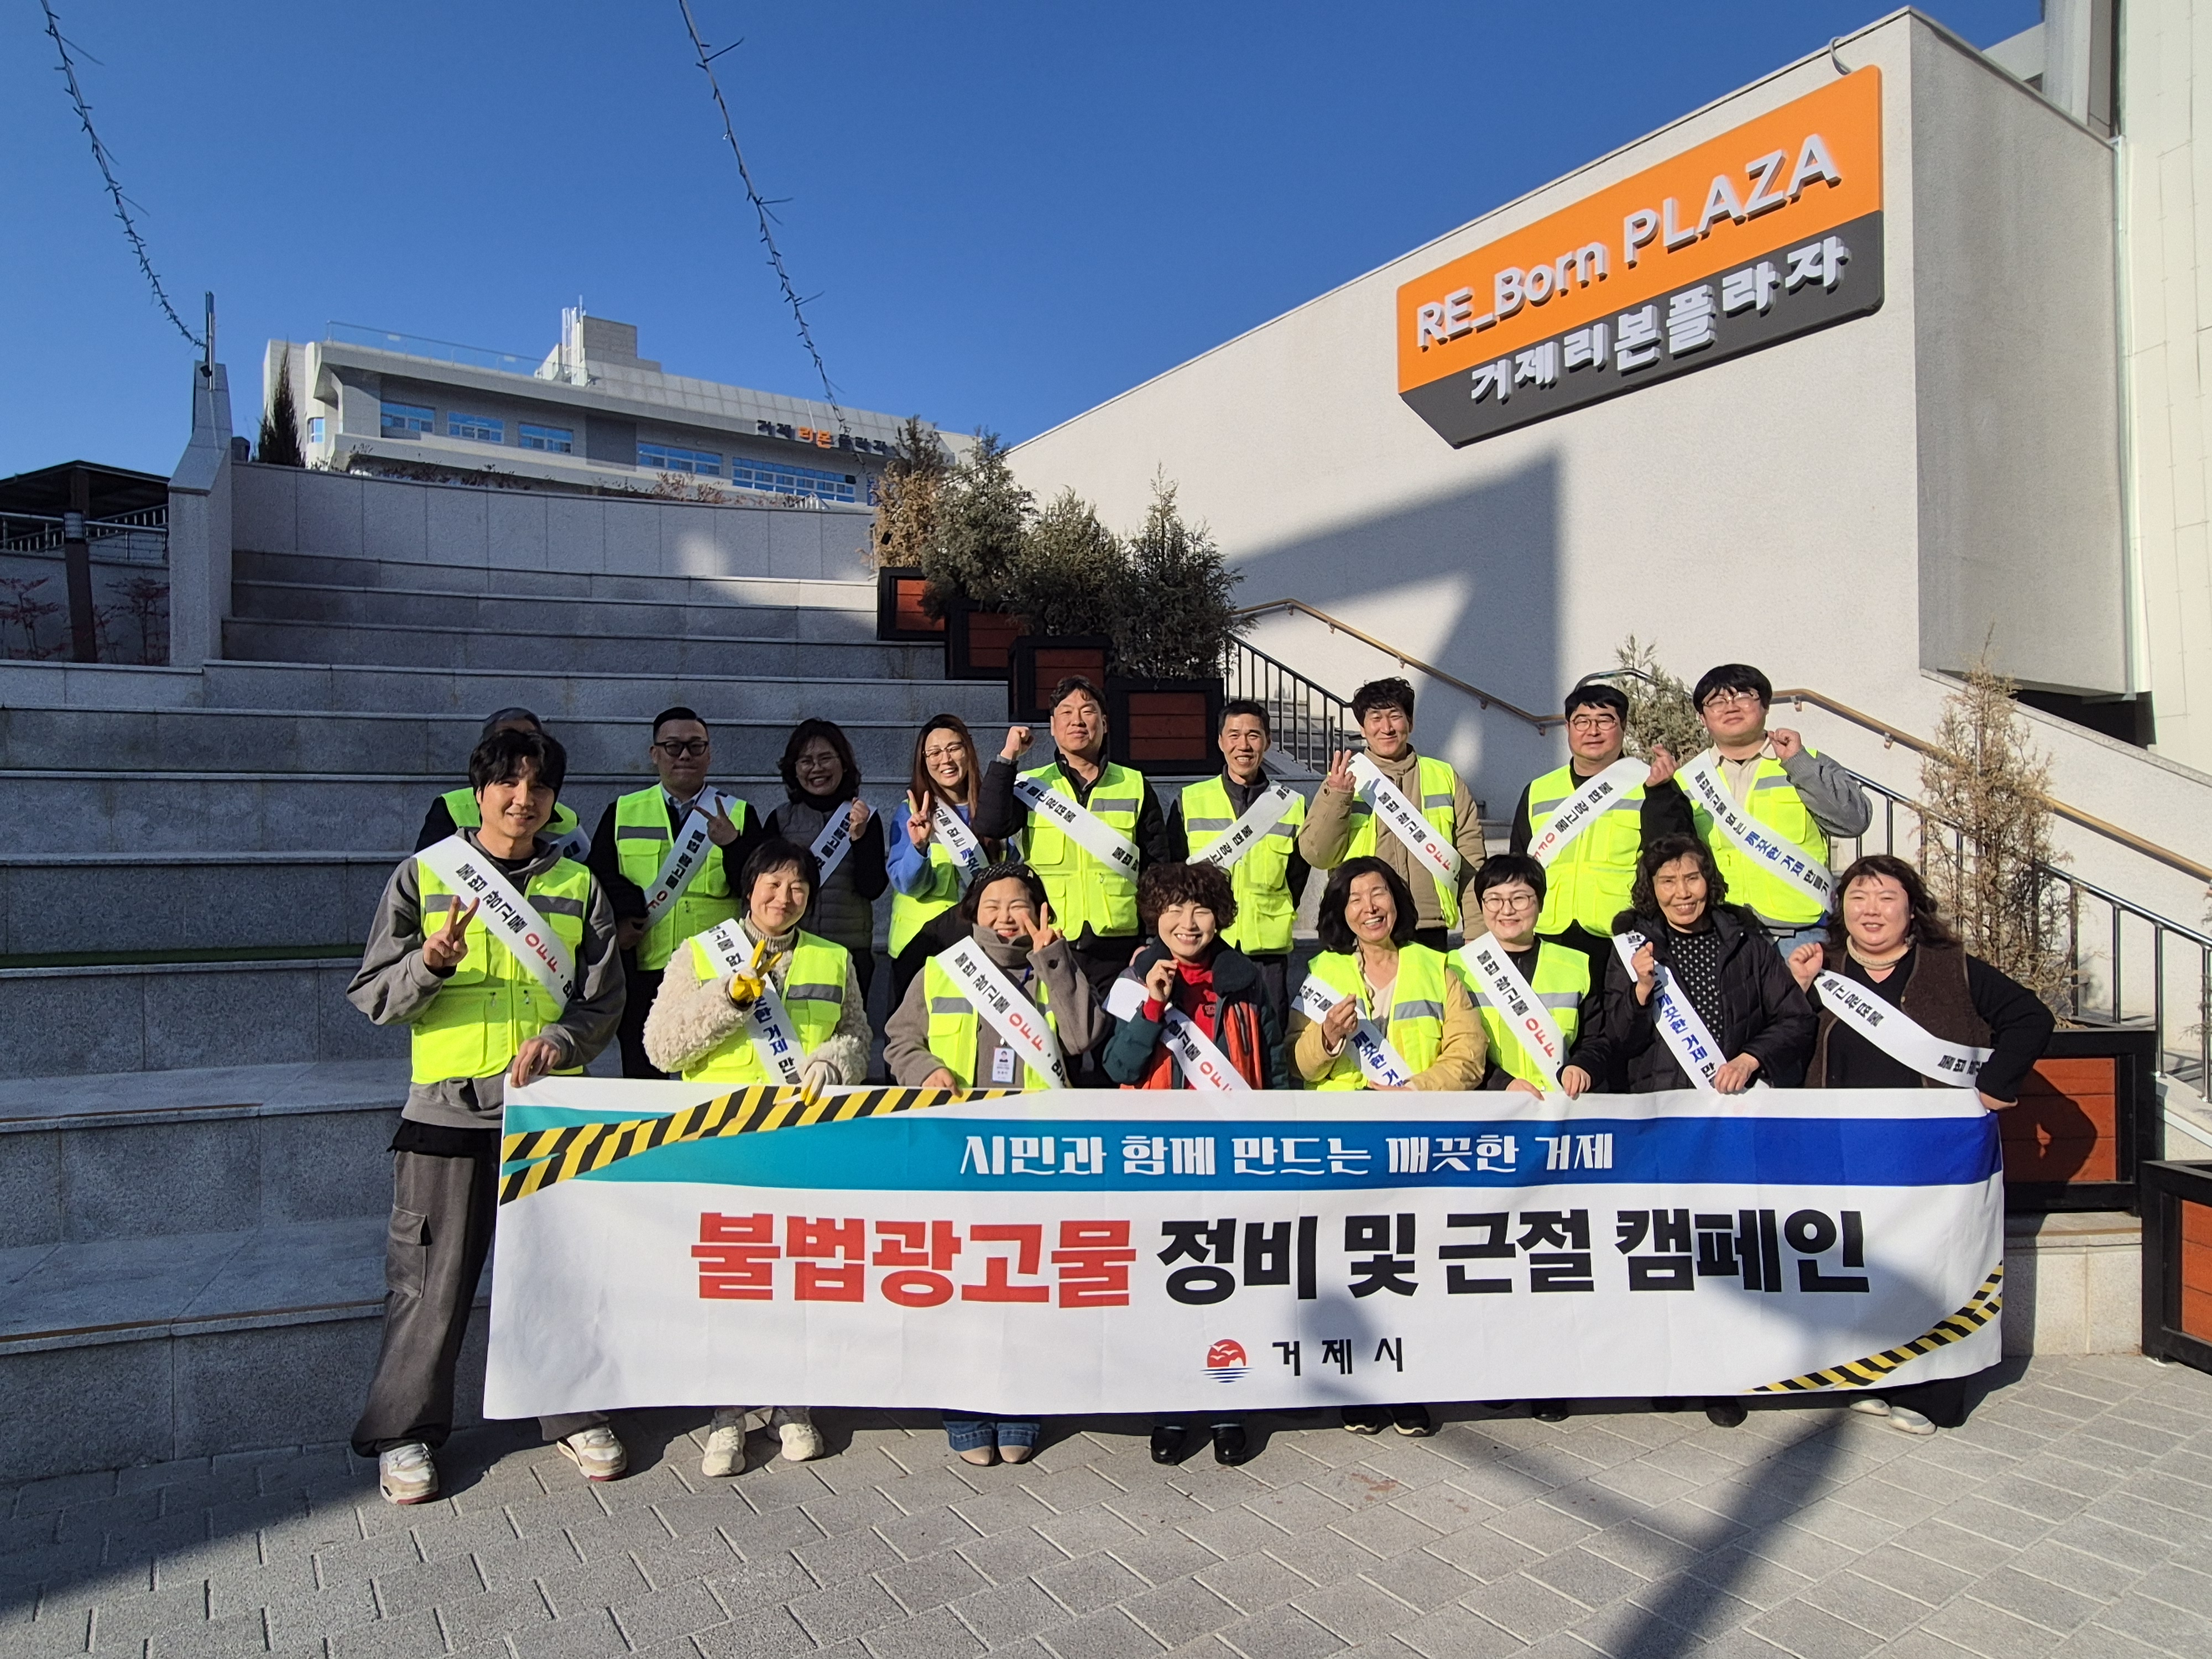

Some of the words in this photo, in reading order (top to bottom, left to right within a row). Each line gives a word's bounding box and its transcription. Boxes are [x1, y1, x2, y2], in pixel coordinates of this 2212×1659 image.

[1417, 242, 1608, 347] RE_Born
[1624, 133, 1841, 265] PLAZA
[1472, 235, 1850, 401] 거제리본플라자
[646, 890, 668, 914] OF
[961, 1136, 1107, 1176] 시민과
[1121, 1136, 1215, 1176] 함께
[1232, 1137, 1372, 1176] 만드는
[1386, 1135, 1519, 1173] 깨끗한
[1535, 1133, 1613, 1170] 거제
[692, 1212, 1136, 1308] 불법광고물
[1156, 1215, 1318, 1305] 정비
[1344, 1213, 1419, 1298] 및
[1438, 1209, 1594, 1295] 근절
[1615, 1208, 1870, 1293] 캠페인
[1272, 1337, 1404, 1376] 거제시
